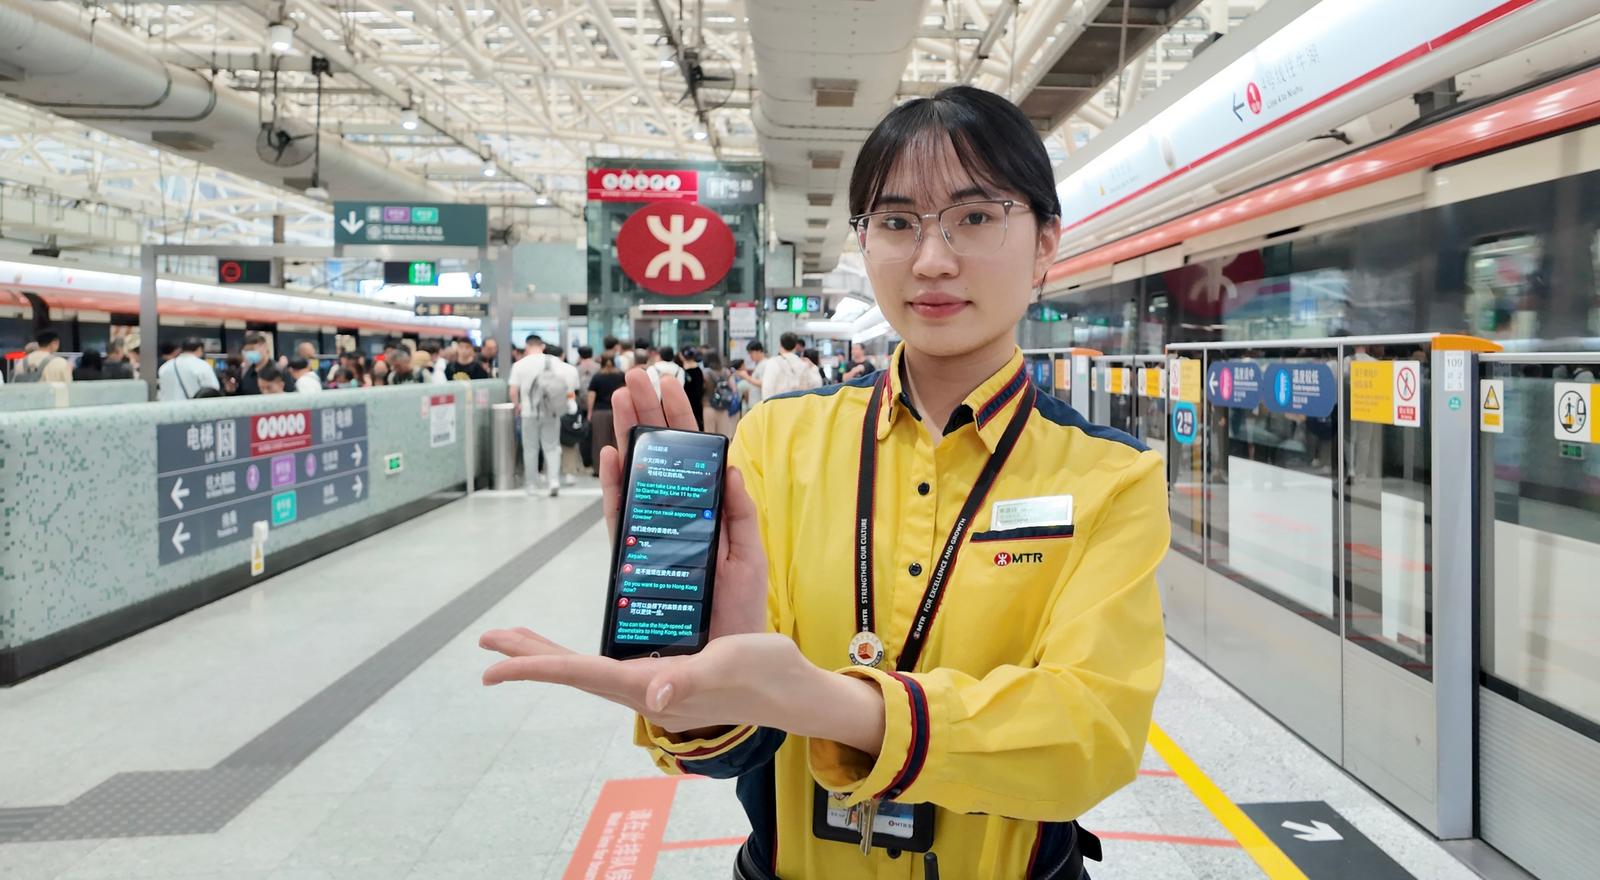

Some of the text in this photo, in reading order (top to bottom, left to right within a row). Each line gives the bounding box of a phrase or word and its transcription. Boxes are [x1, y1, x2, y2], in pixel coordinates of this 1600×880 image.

[1447, 358, 1462, 368] 109
[1177, 411, 1183, 434] 2
[187, 422, 214, 450] 电梯
[1012, 552, 1043, 563] MTR
[916, 518, 966, 632] MTR FOR EXCELLENCE AND GROWTH
